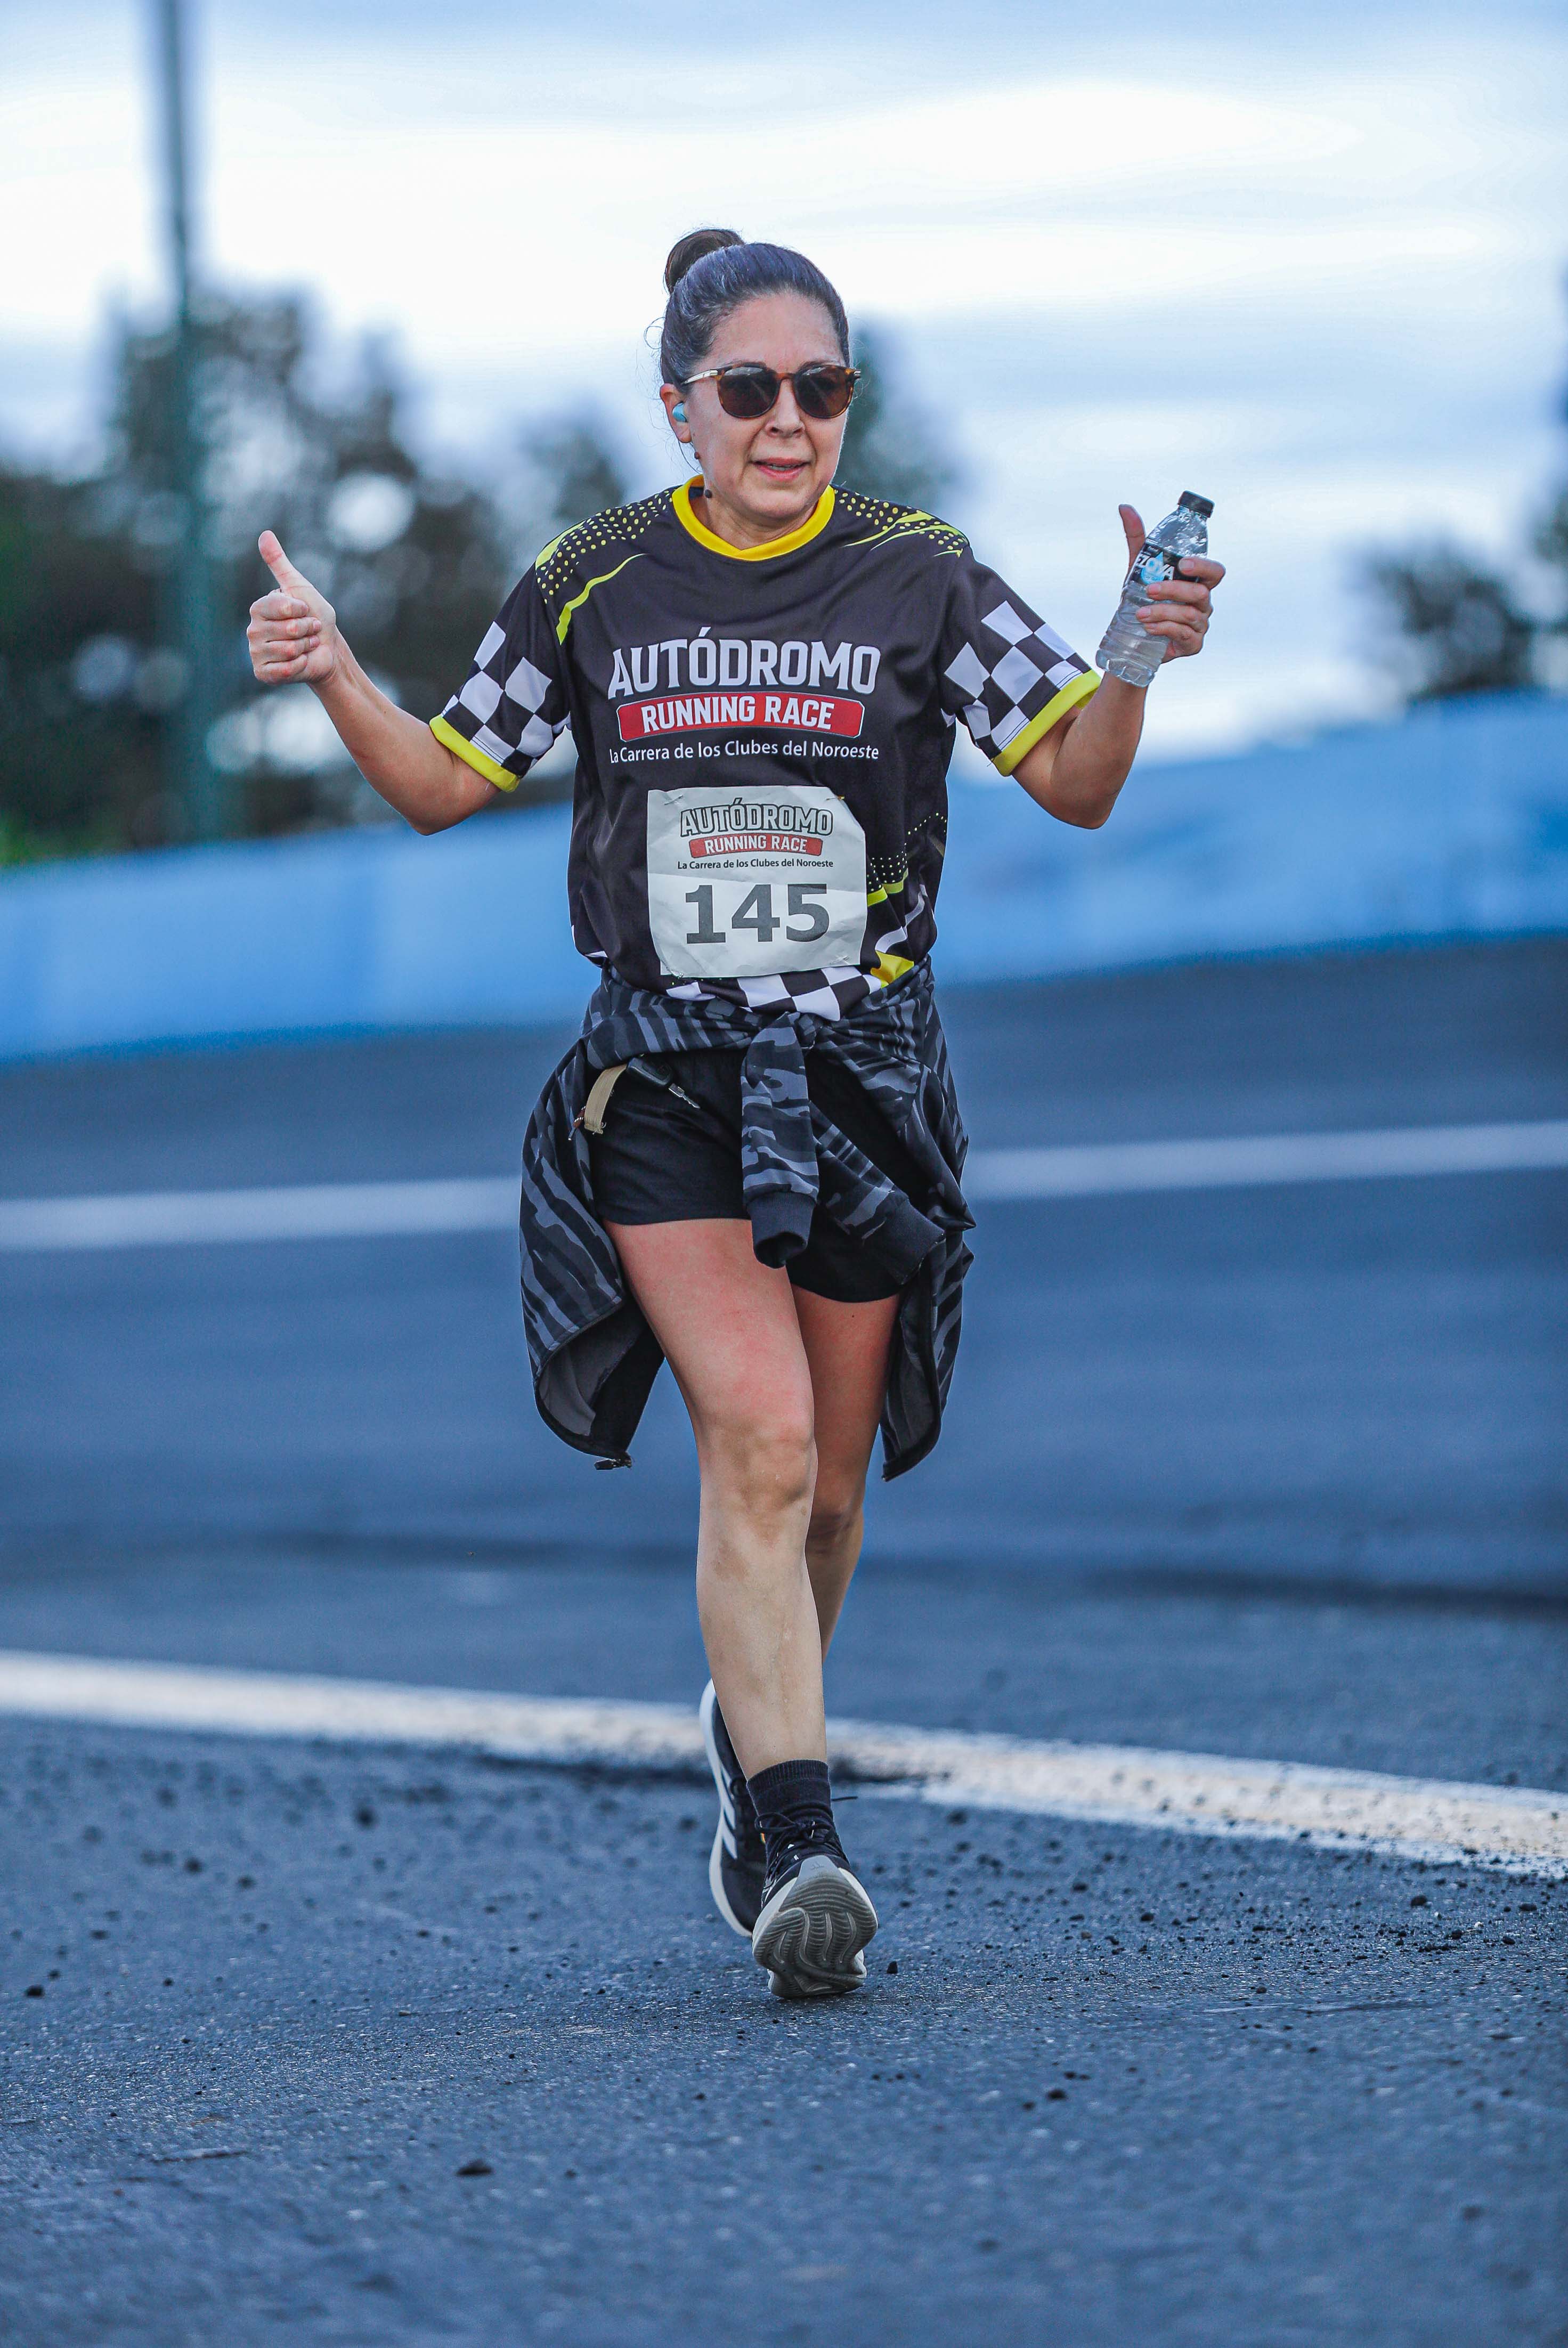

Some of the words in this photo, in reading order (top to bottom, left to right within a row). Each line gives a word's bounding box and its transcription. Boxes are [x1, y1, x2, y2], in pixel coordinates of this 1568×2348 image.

[608, 626, 881, 700] AUTÓDROMO
[640, 695, 756, 734] RUNNING
[764, 696, 835, 730] RACE
[610, 749, 619, 763] La
[620, 746, 670, 762] Carrera
[675, 742, 693, 759] de
[698, 741, 720, 757] los
[725, 740, 778, 755] Clubes
[783, 740, 807, 756] del
[812, 742, 879, 760] Noroeste
[680, 798, 833, 837] AUTÓDROMO
[704, 834, 767, 854] RUNNING
[771, 835, 807, 853] RACE
[677, 861, 687, 870] La
[689, 860, 721, 870] Carrera
[723, 859, 734, 868] de
[736, 859, 749, 868] los
[750, 858, 779, 867] Clubes
[781, 858, 794, 867] del
[797, 859, 833, 868] Noroeste
[685, 883, 830, 944] 145
